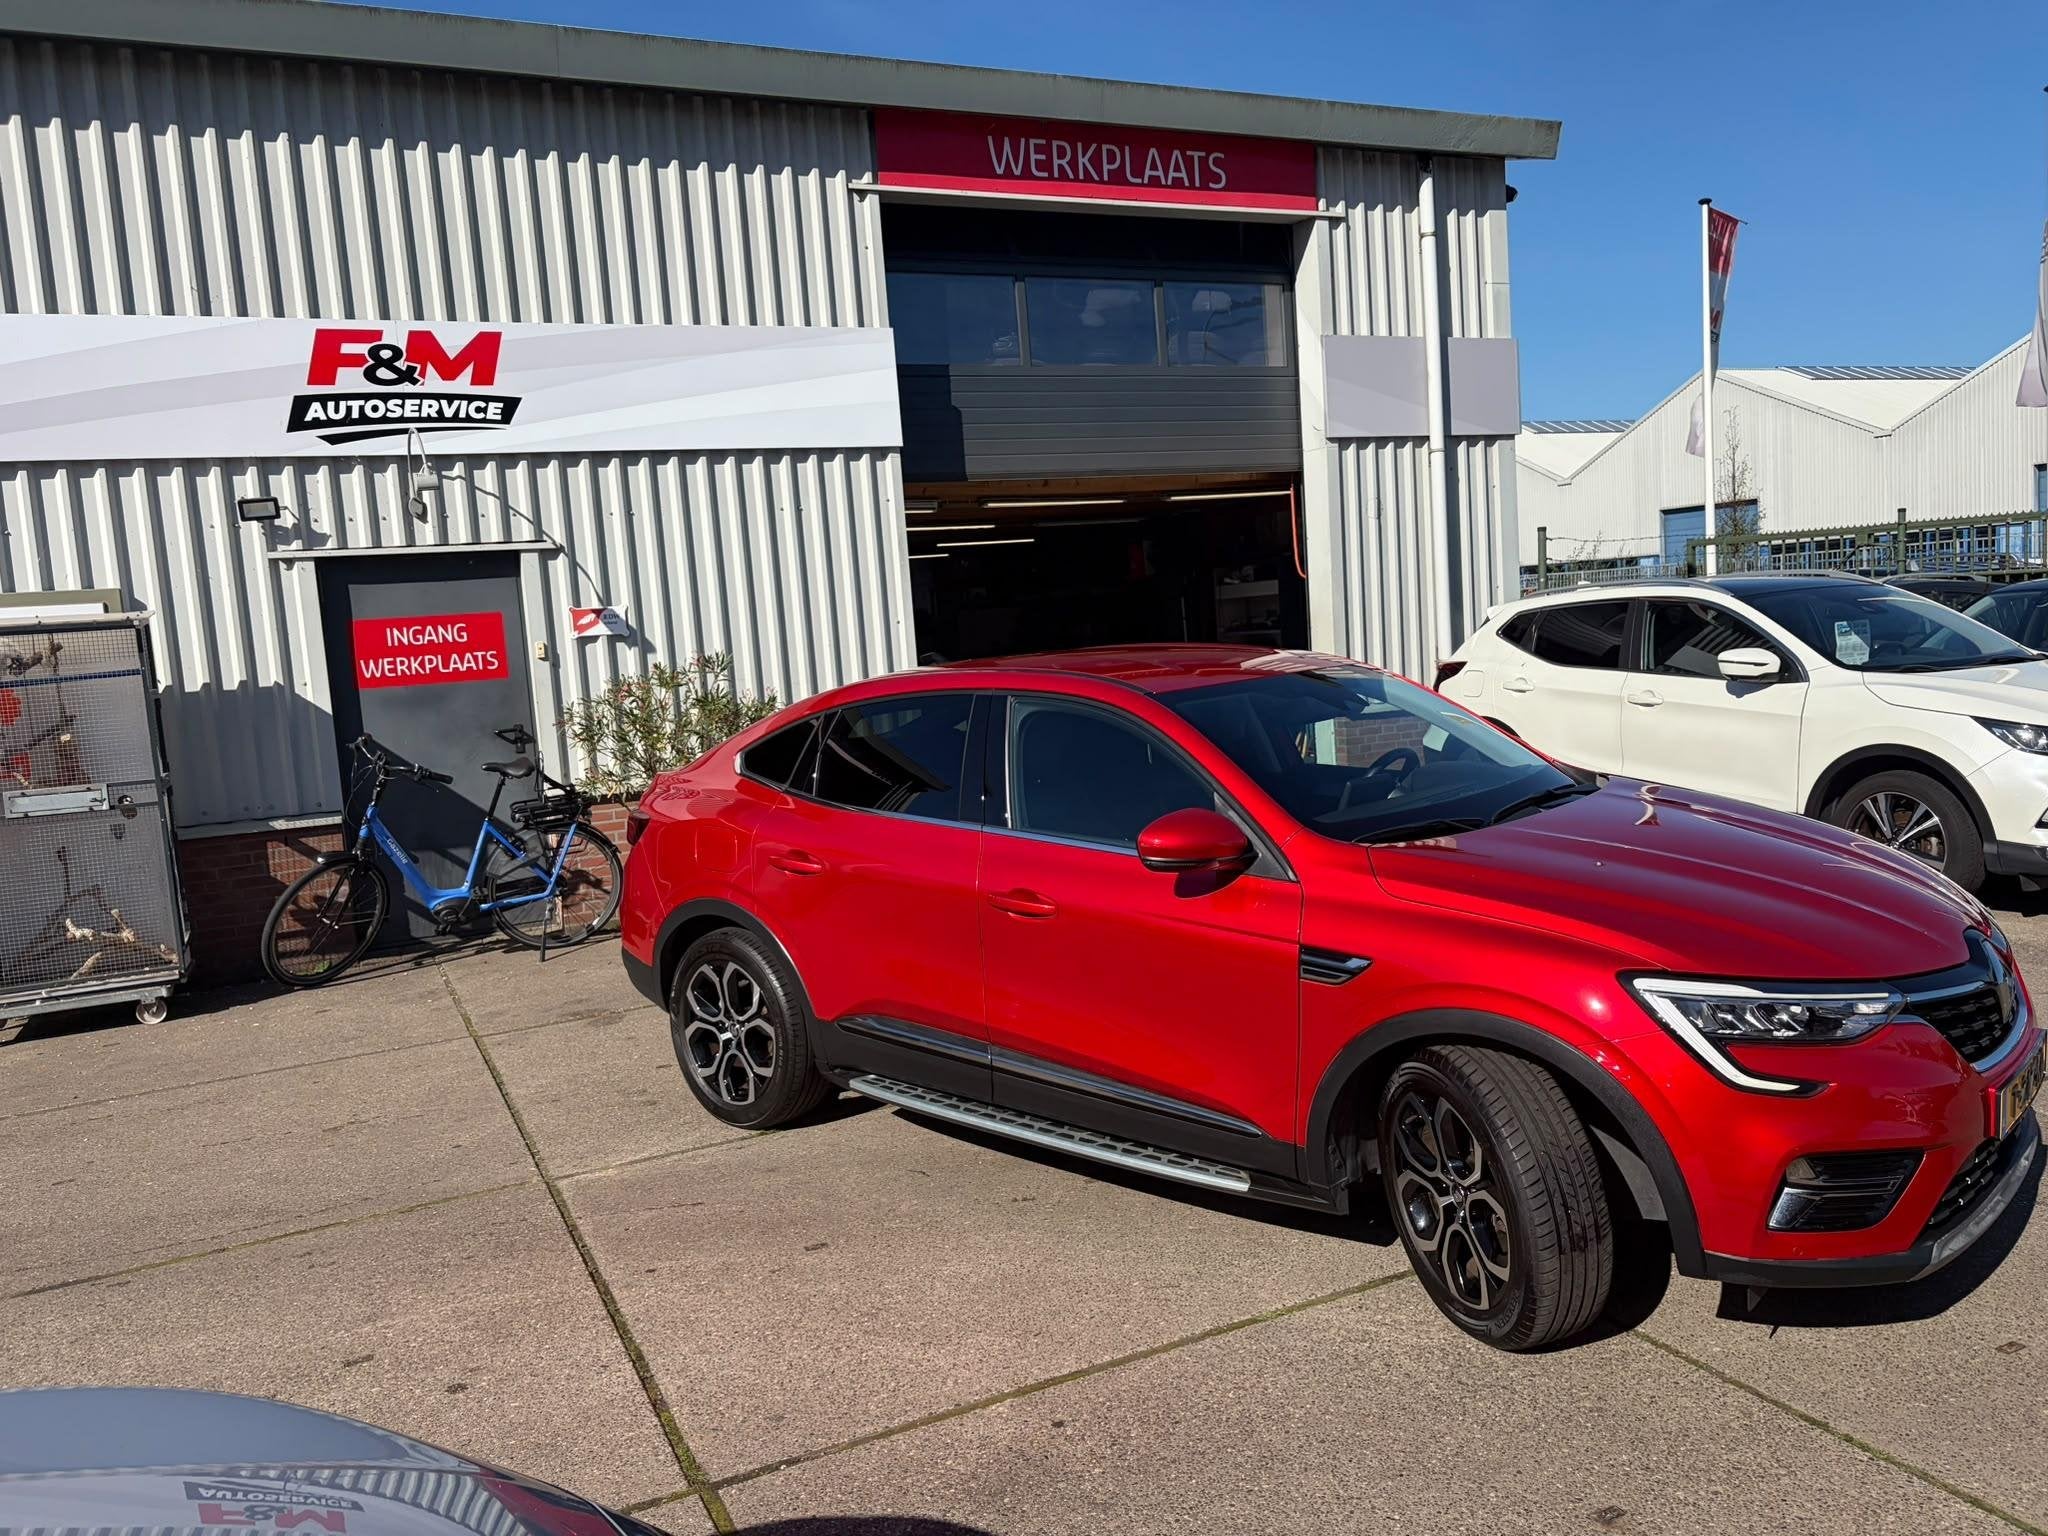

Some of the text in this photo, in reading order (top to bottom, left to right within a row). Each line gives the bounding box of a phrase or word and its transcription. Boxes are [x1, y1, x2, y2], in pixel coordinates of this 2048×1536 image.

[987, 135, 1227, 190] WERKPLAATS
[306, 327, 503, 387] F&M
[303, 398, 504, 422] AUTOSERVICE
[386, 623, 468, 648] INGANG
[360, 651, 500, 680] WERKPLAATS
